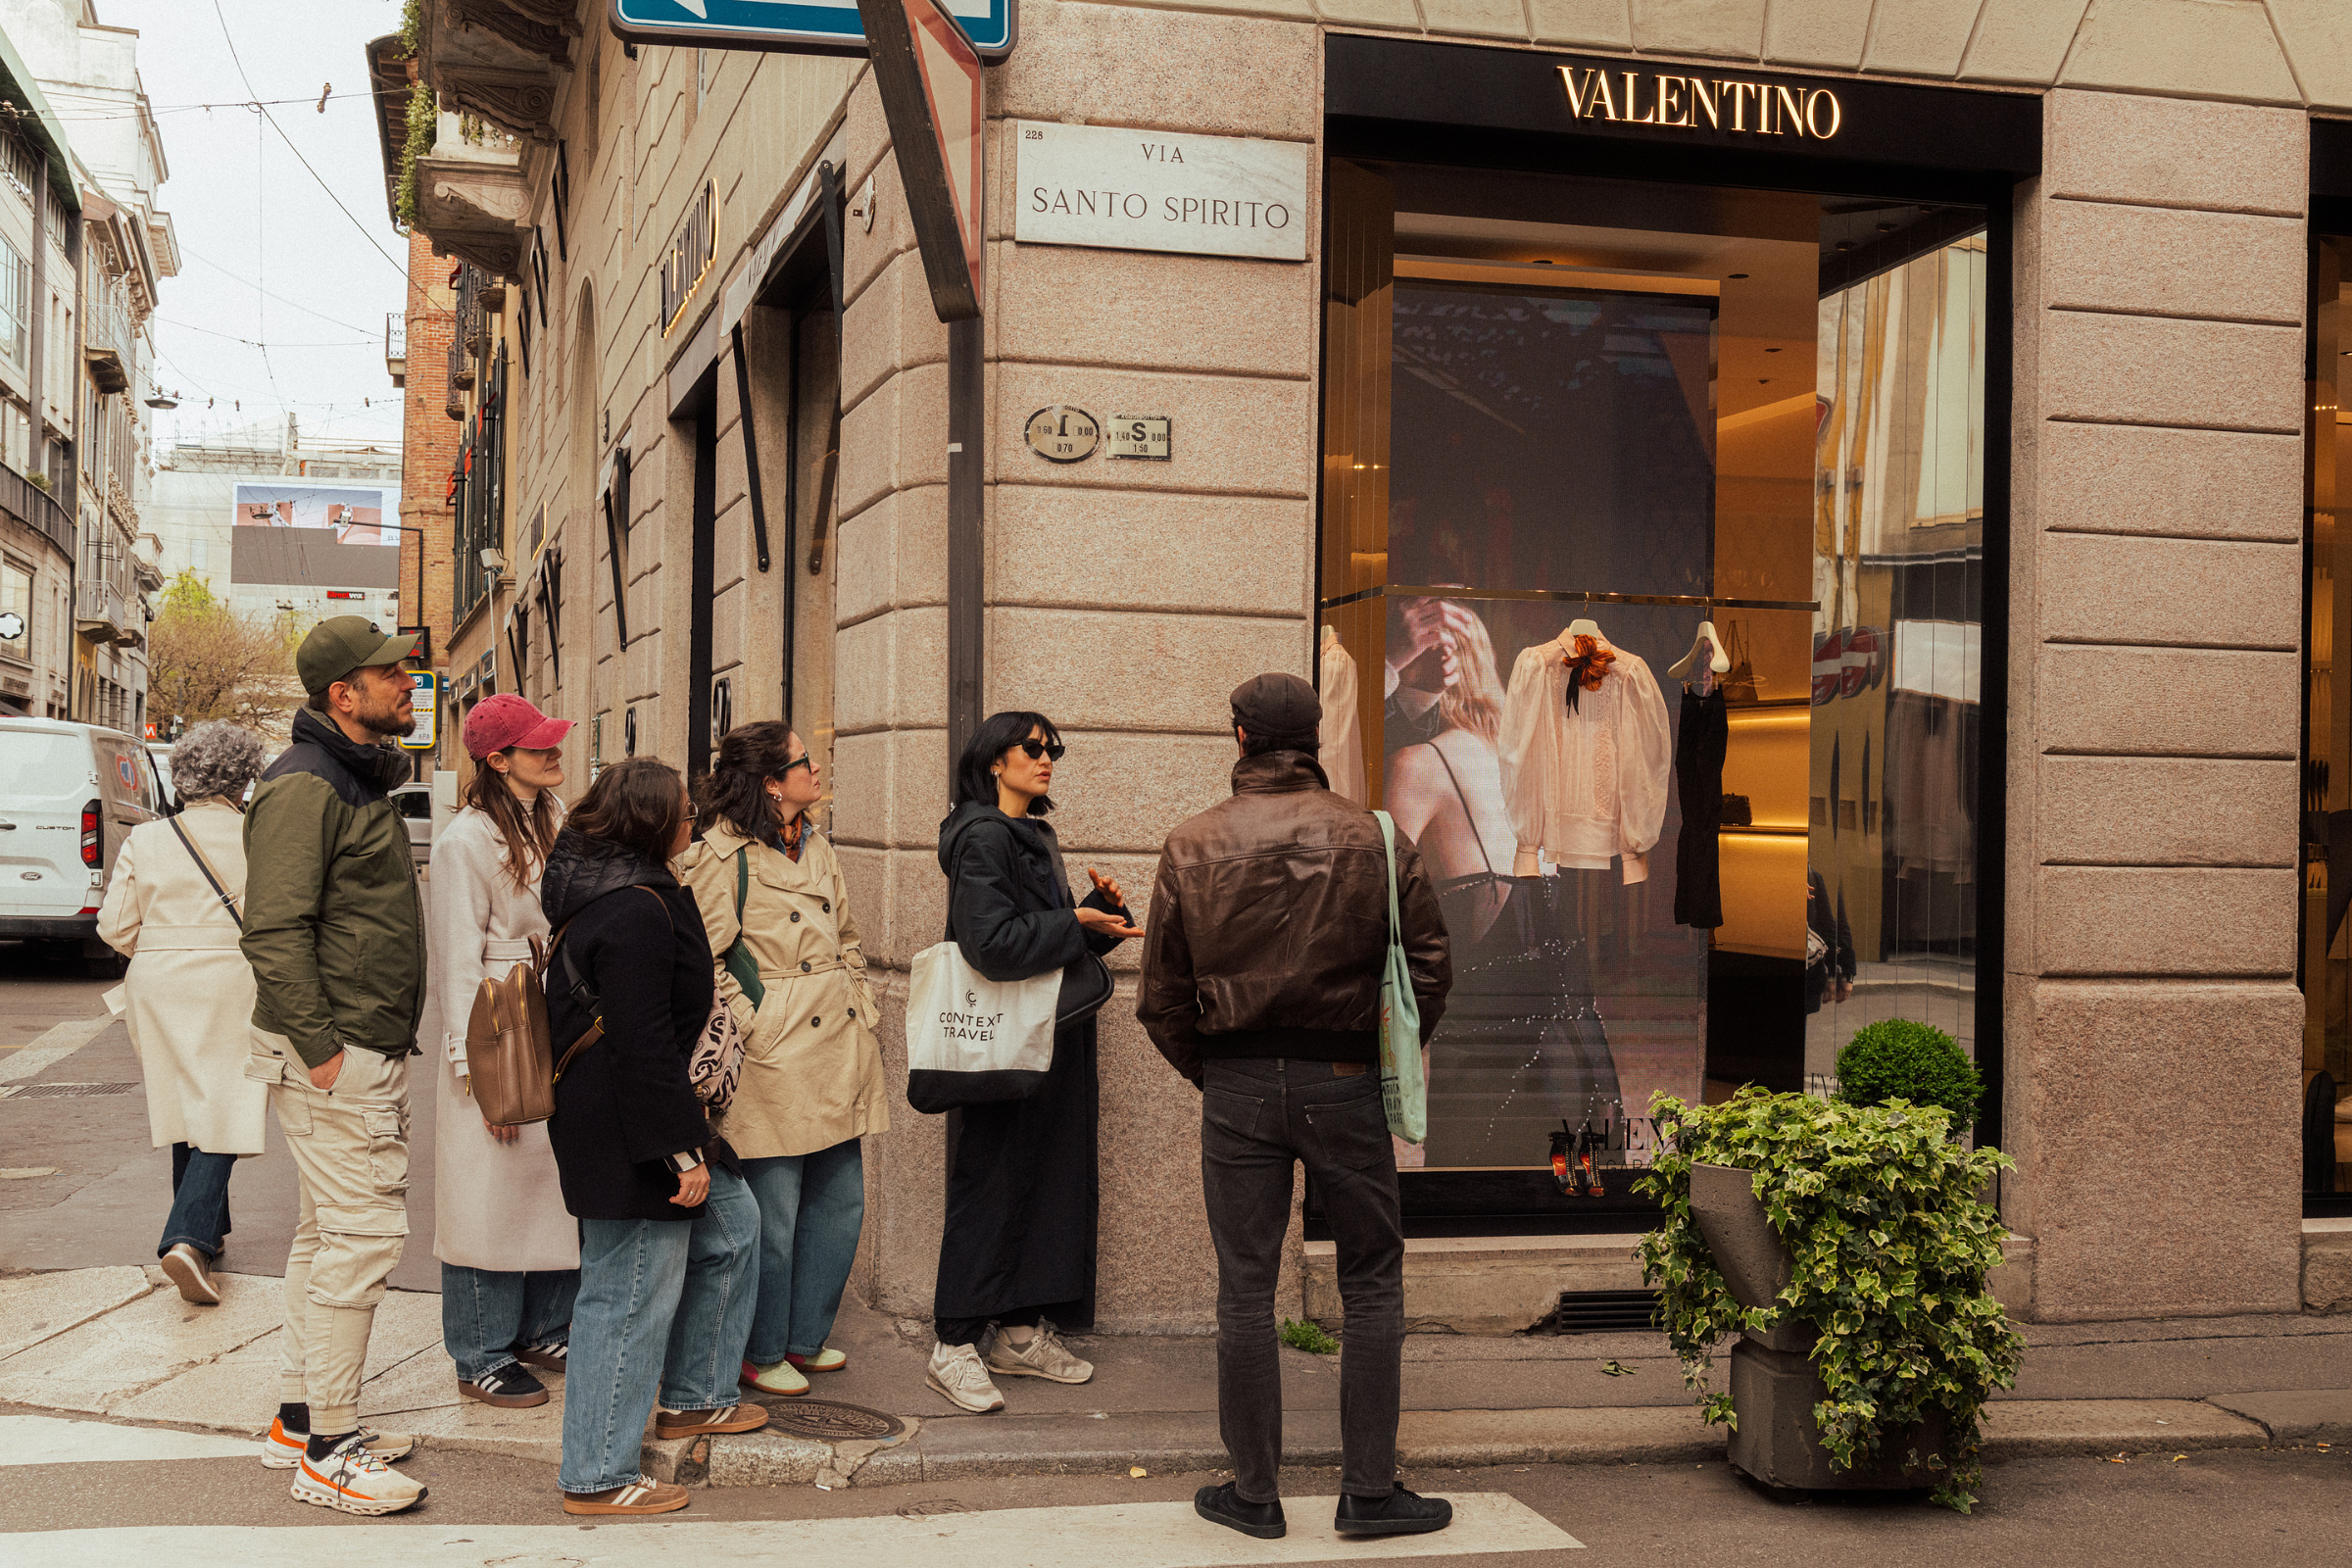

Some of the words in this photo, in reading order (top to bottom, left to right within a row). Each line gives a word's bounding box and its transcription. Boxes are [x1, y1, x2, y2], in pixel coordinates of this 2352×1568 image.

[1556, 66, 1840, 139] VALENTINO
[1025, 129, 1044, 140] 228
[1141, 143, 1185, 164] VIA
[1032, 186, 1148, 219] SANTO
[1163, 196, 1290, 229] SPIRITO
[1131, 421, 1147, 442] S
[939, 1011, 1004, 1027] CONTEXT
[943, 1026, 995, 1041] TRAVEL
